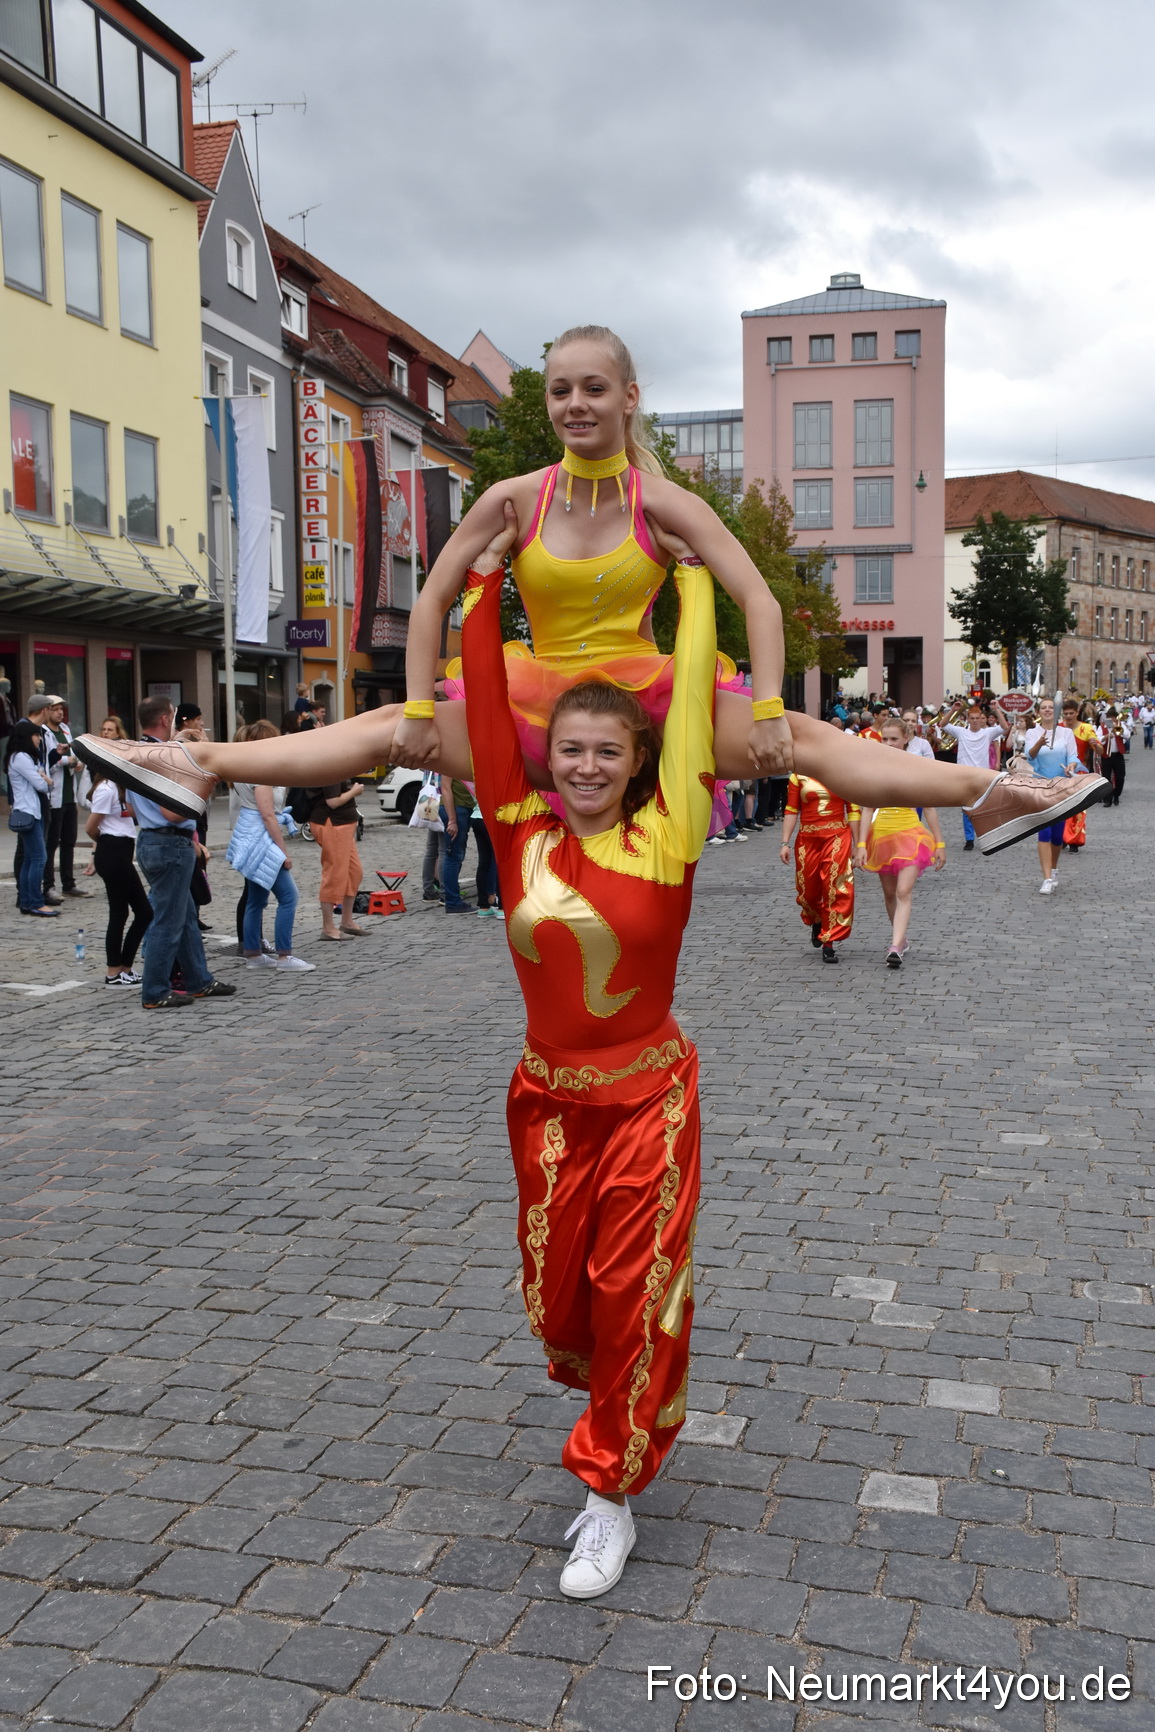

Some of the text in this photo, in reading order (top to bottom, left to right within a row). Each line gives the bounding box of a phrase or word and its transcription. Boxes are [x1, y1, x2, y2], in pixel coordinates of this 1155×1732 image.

[302, 381, 320, 559] BÄCKEREI
[304, 567, 325, 580] café
[840, 617, 895, 631] arkasse
[290, 626, 325, 641] liberty
